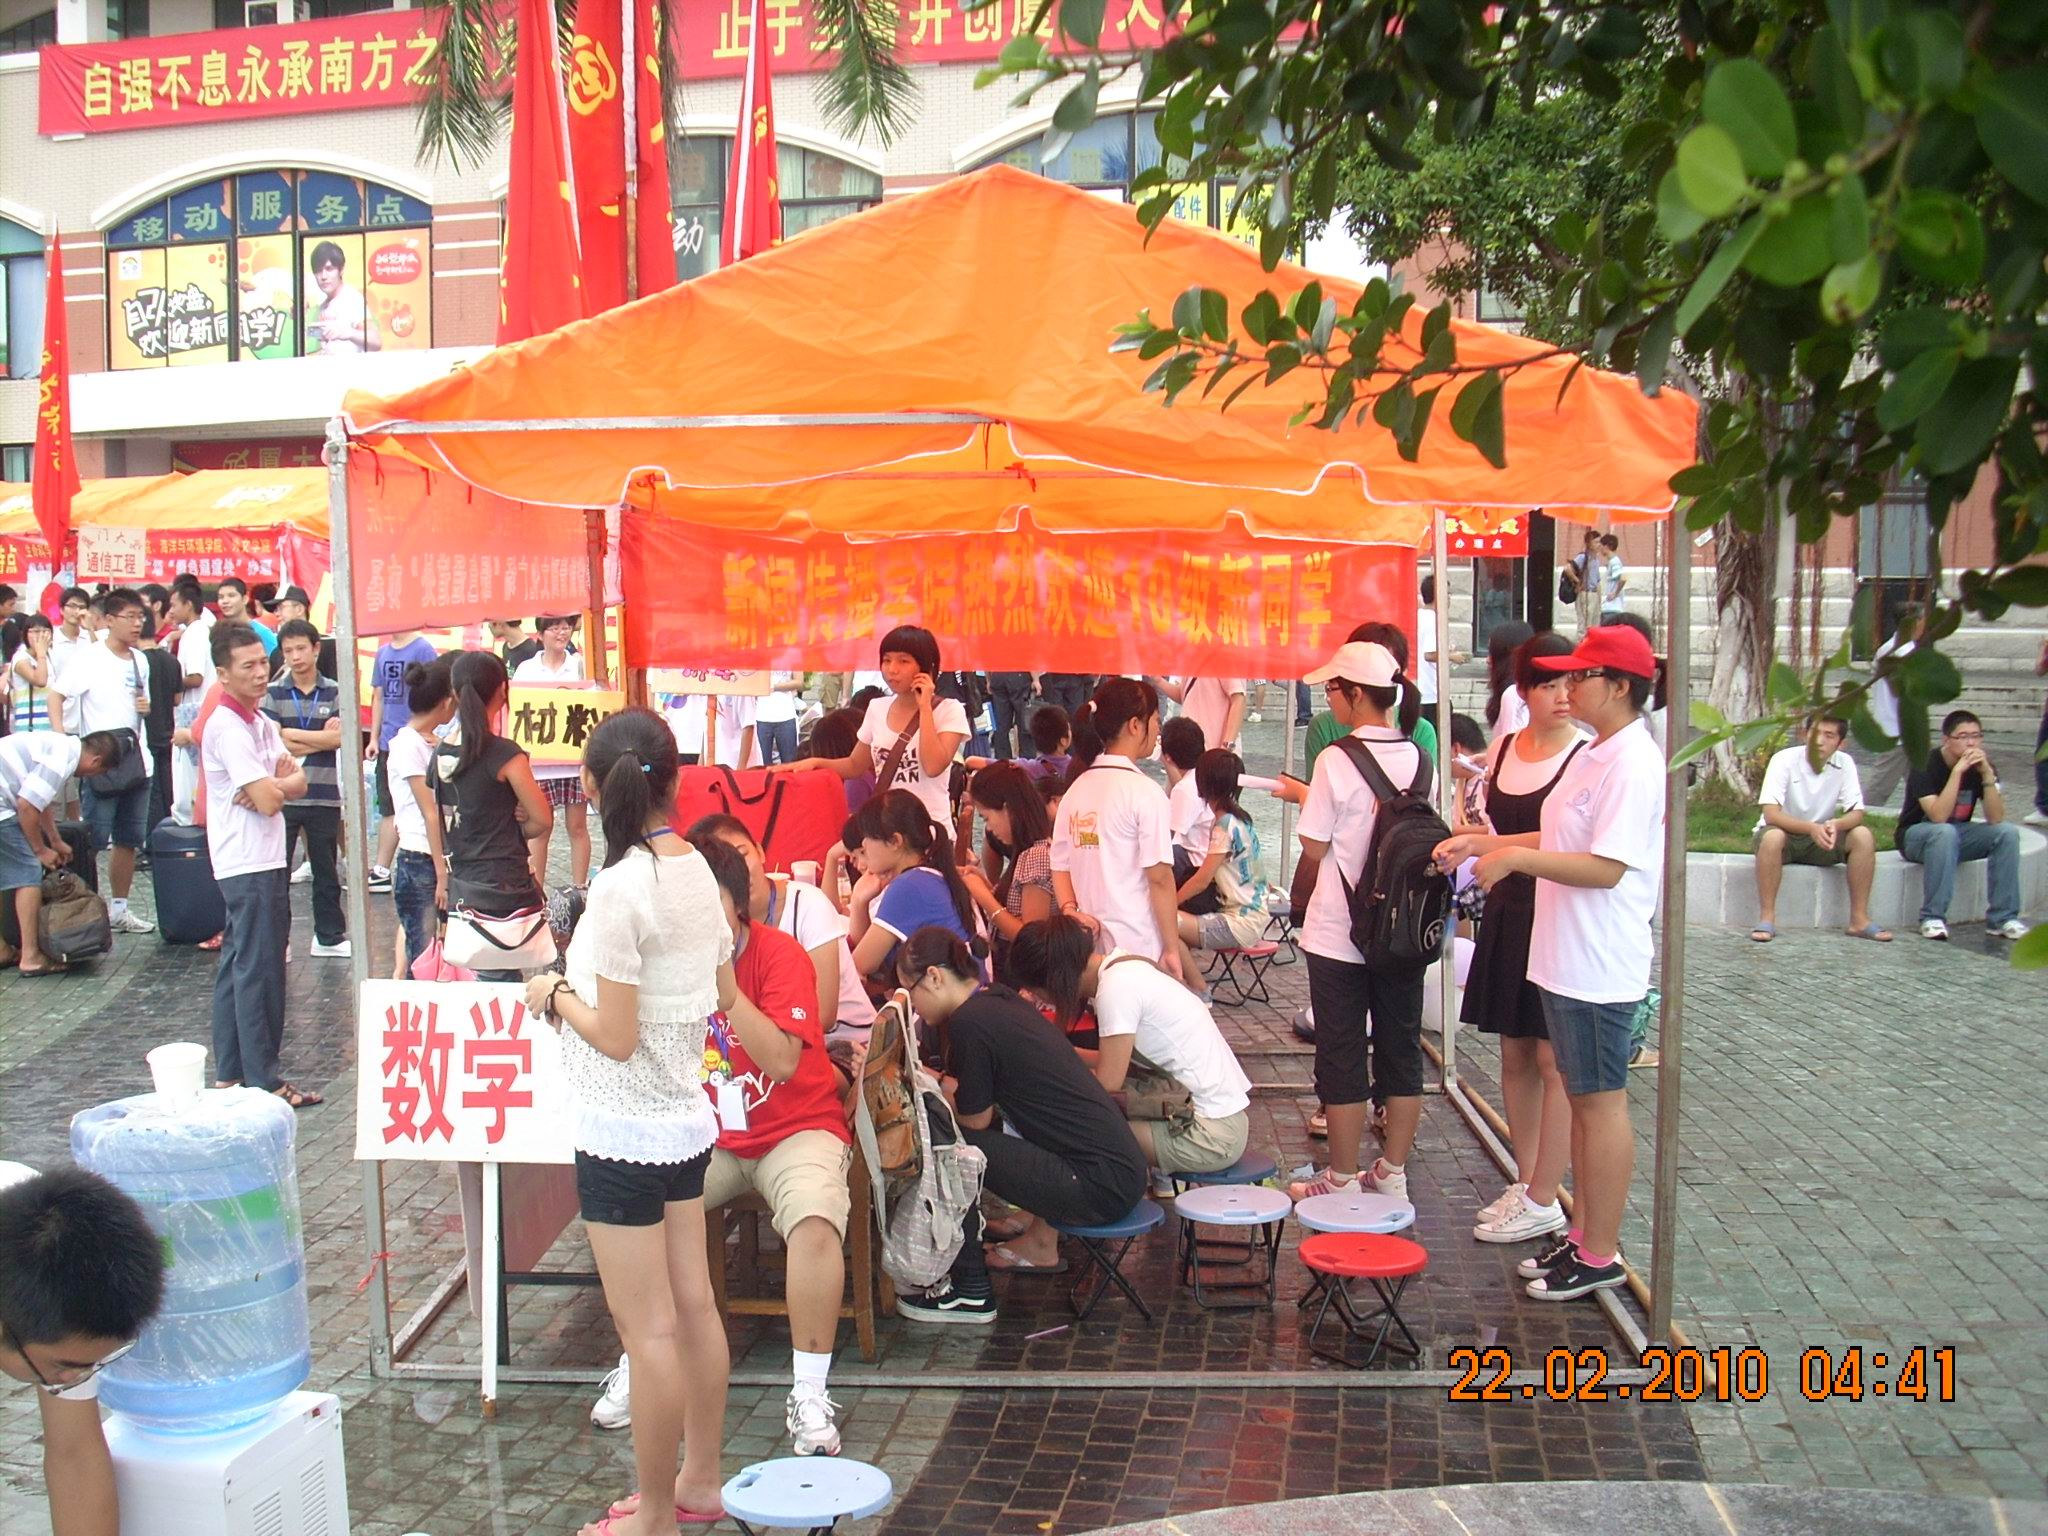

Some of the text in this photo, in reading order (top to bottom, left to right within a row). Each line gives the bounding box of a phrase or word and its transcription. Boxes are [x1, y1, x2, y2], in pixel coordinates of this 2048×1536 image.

[85, 17, 518, 117] 自强不息永承南方之
[133, 190, 405, 242] 移动服务点
[87, 551, 137, 575] 通信工程
[381, 996, 533, 1145] 数学
